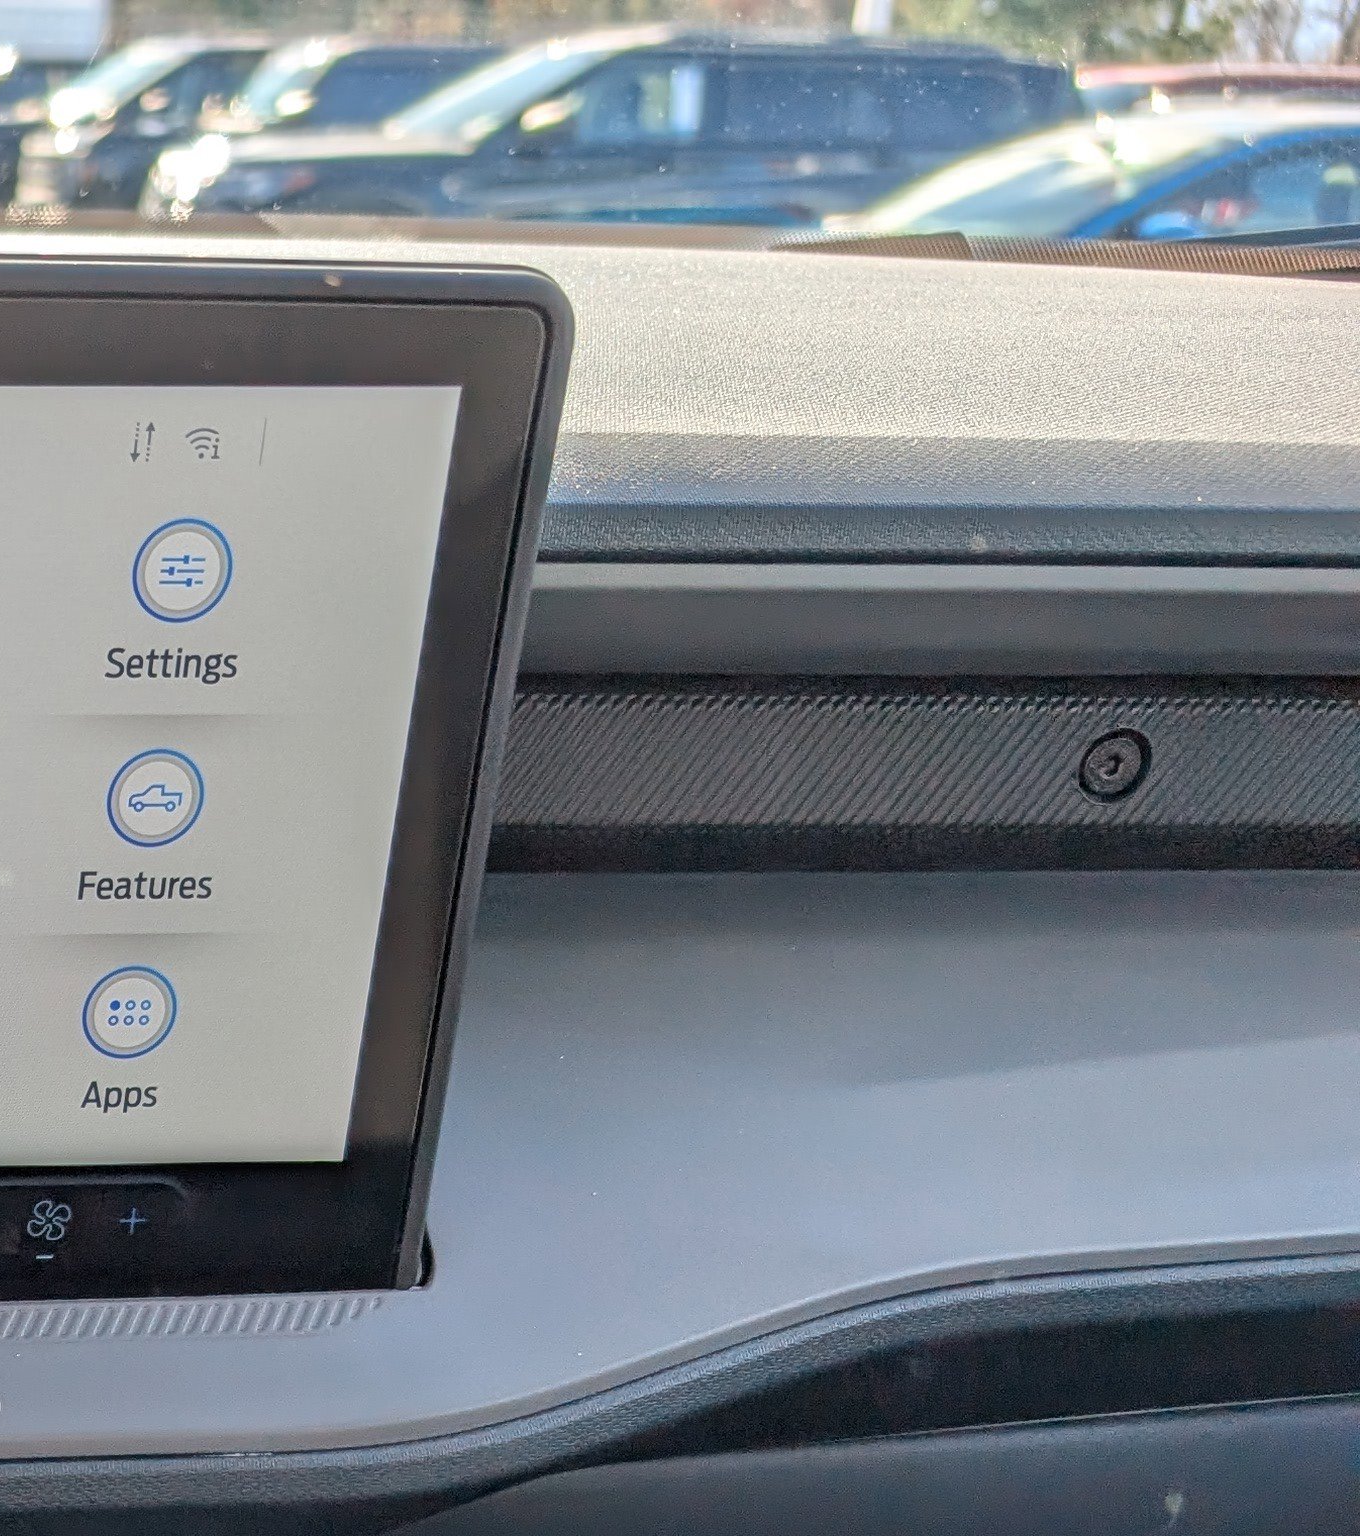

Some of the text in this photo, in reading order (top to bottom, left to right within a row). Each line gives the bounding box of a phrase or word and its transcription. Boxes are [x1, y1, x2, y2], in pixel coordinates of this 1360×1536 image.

[104, 647, 238, 685] Settings
[77, 871, 212, 900] Features
[81, 1079, 158, 1115] Apps
